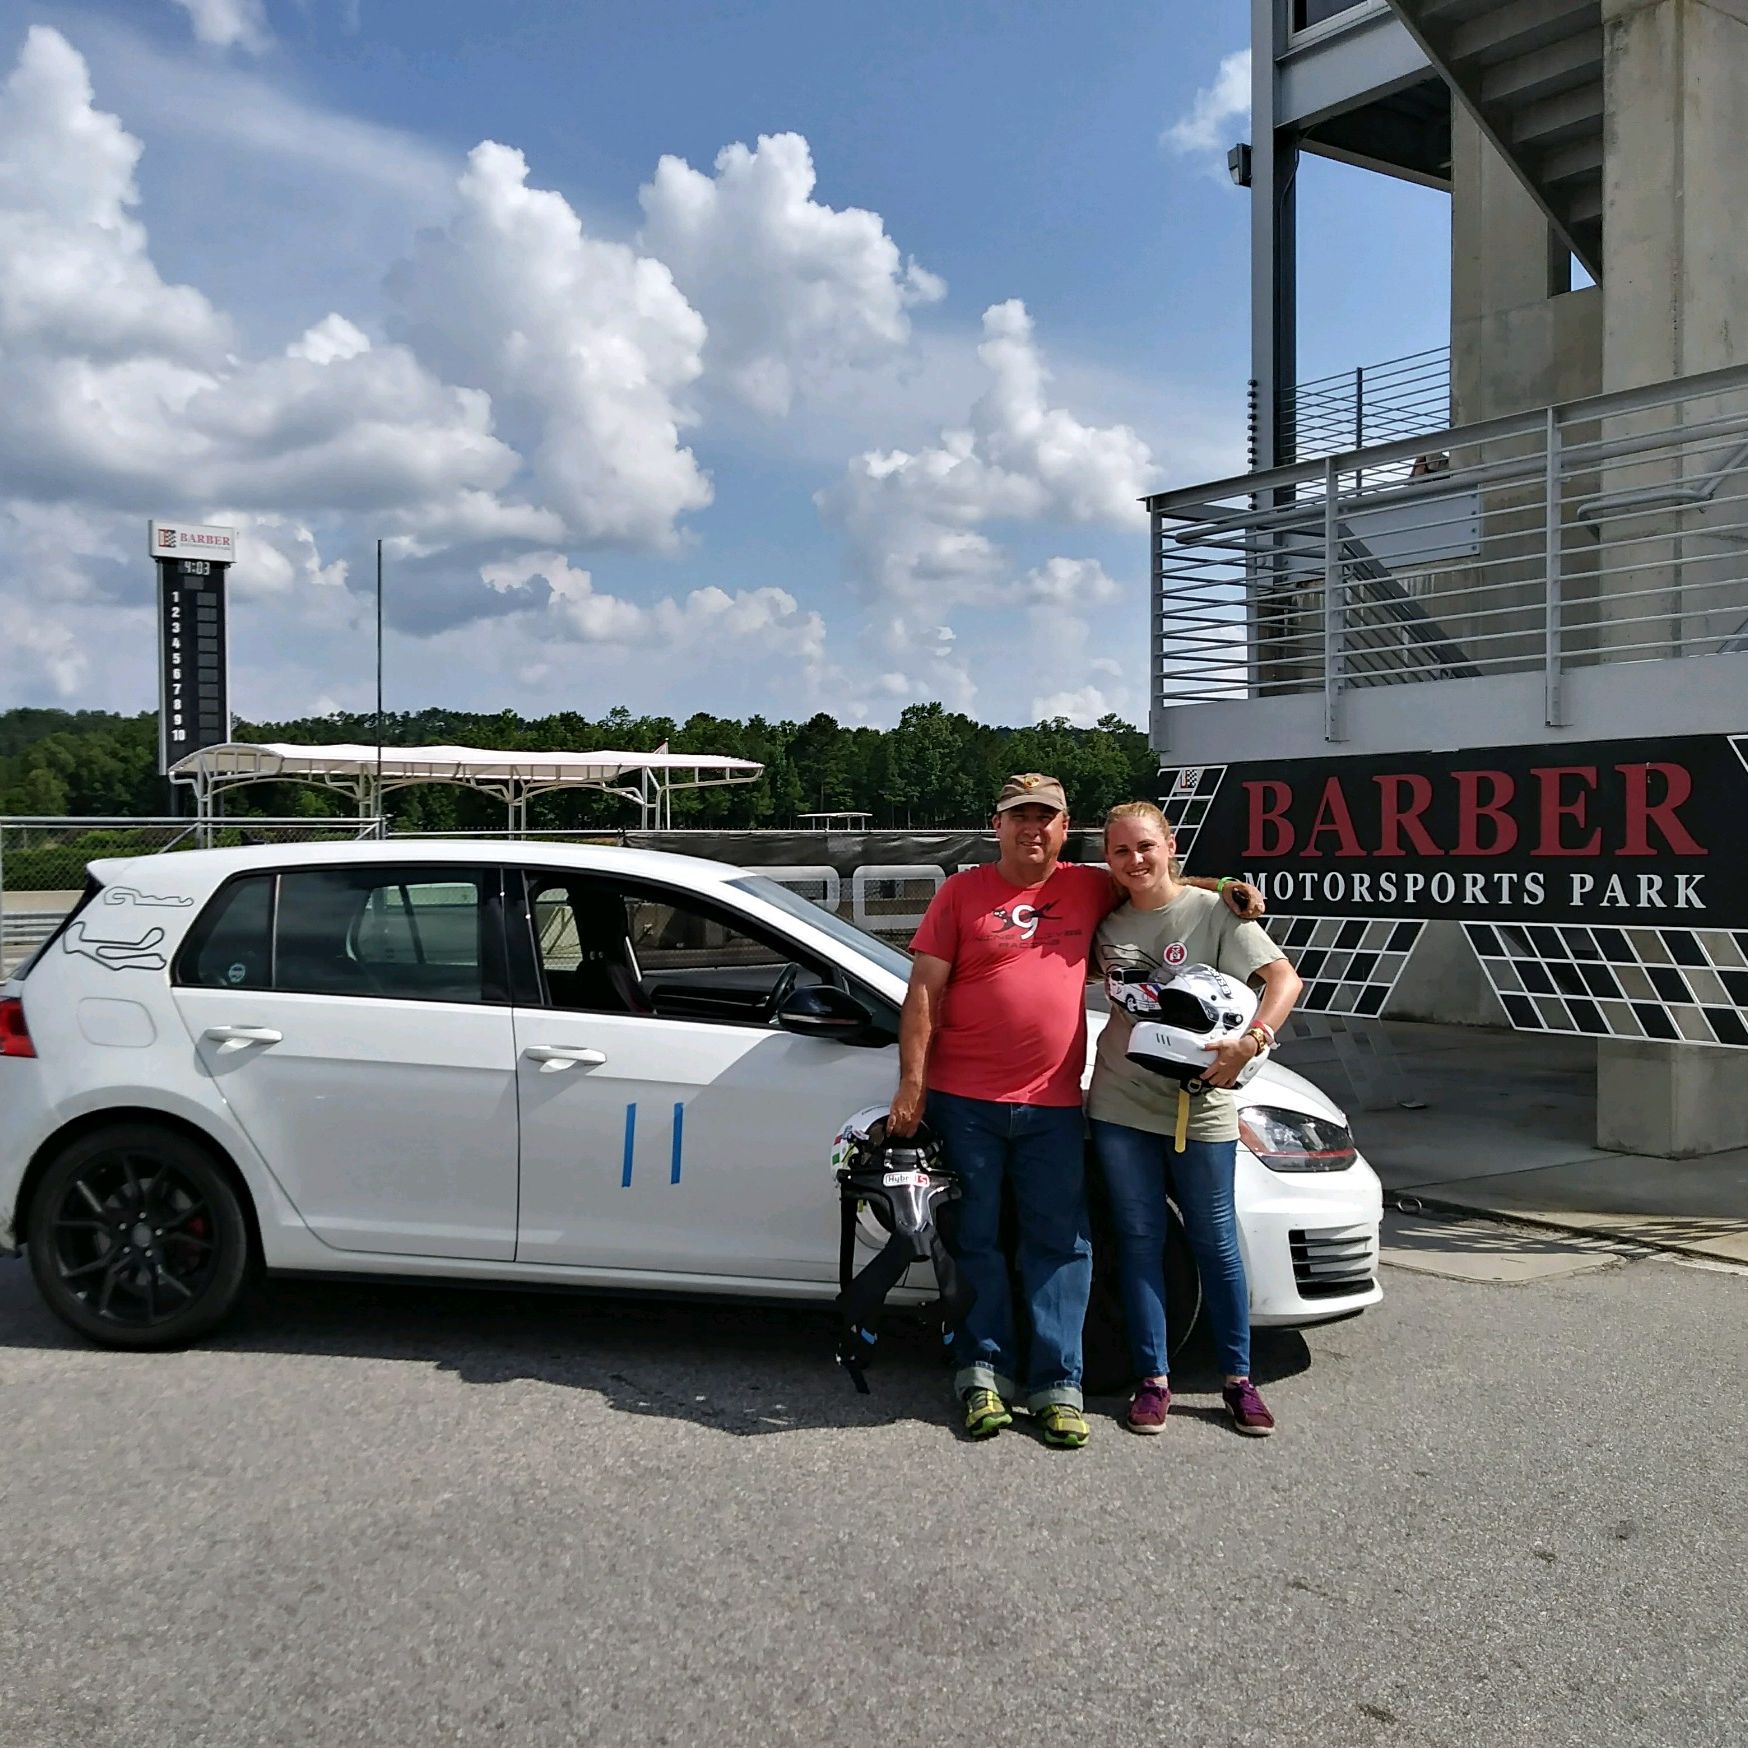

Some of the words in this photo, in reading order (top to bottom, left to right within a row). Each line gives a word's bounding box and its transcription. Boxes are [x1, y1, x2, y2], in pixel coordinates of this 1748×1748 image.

[180, 532, 231, 546] BARBER
[184, 561, 210, 575] 4:03
[171, 591, 179, 602] 1
[171, 606, 180, 618] 2
[171, 622, 180, 633] 3
[171, 637, 181, 648] 4
[172, 653, 181, 664] 5
[172, 668, 182, 679] 6
[172, 683, 182, 695] 7
[173, 699, 182, 710] 8
[173, 714, 182, 725] 9
[171, 729, 186, 741] 10
[1241, 761, 1709, 858] BARBER
[1243, 870, 1546, 906] MOTORSPORTS
[1569, 873, 1707, 909] PARK
